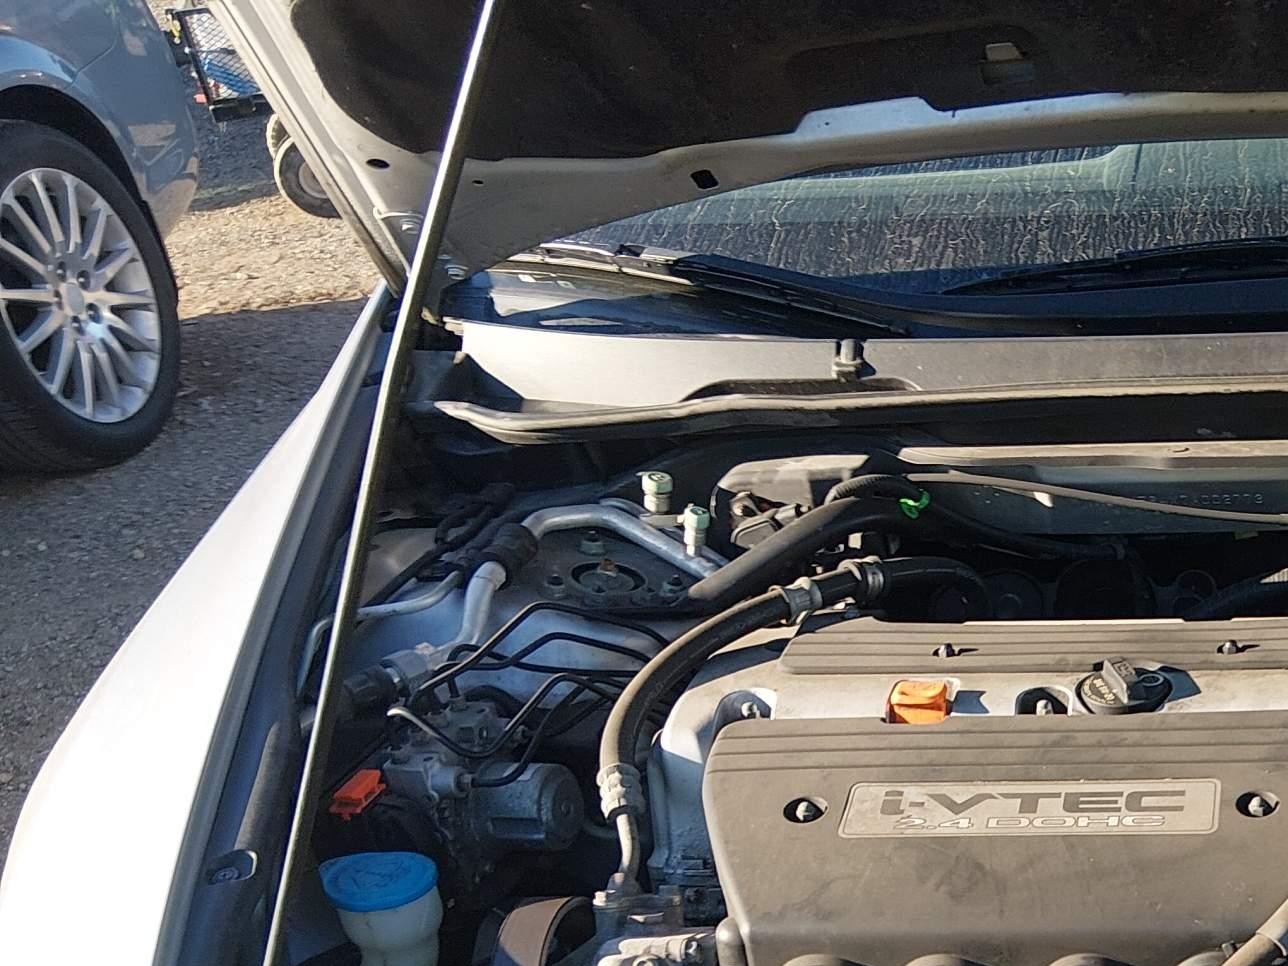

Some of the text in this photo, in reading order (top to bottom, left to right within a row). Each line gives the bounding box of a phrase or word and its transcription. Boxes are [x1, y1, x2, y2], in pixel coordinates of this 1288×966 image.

[880, 790, 1186, 816] i-VTEC
[895, 815, 1166, 830] 2.4 DOHC
